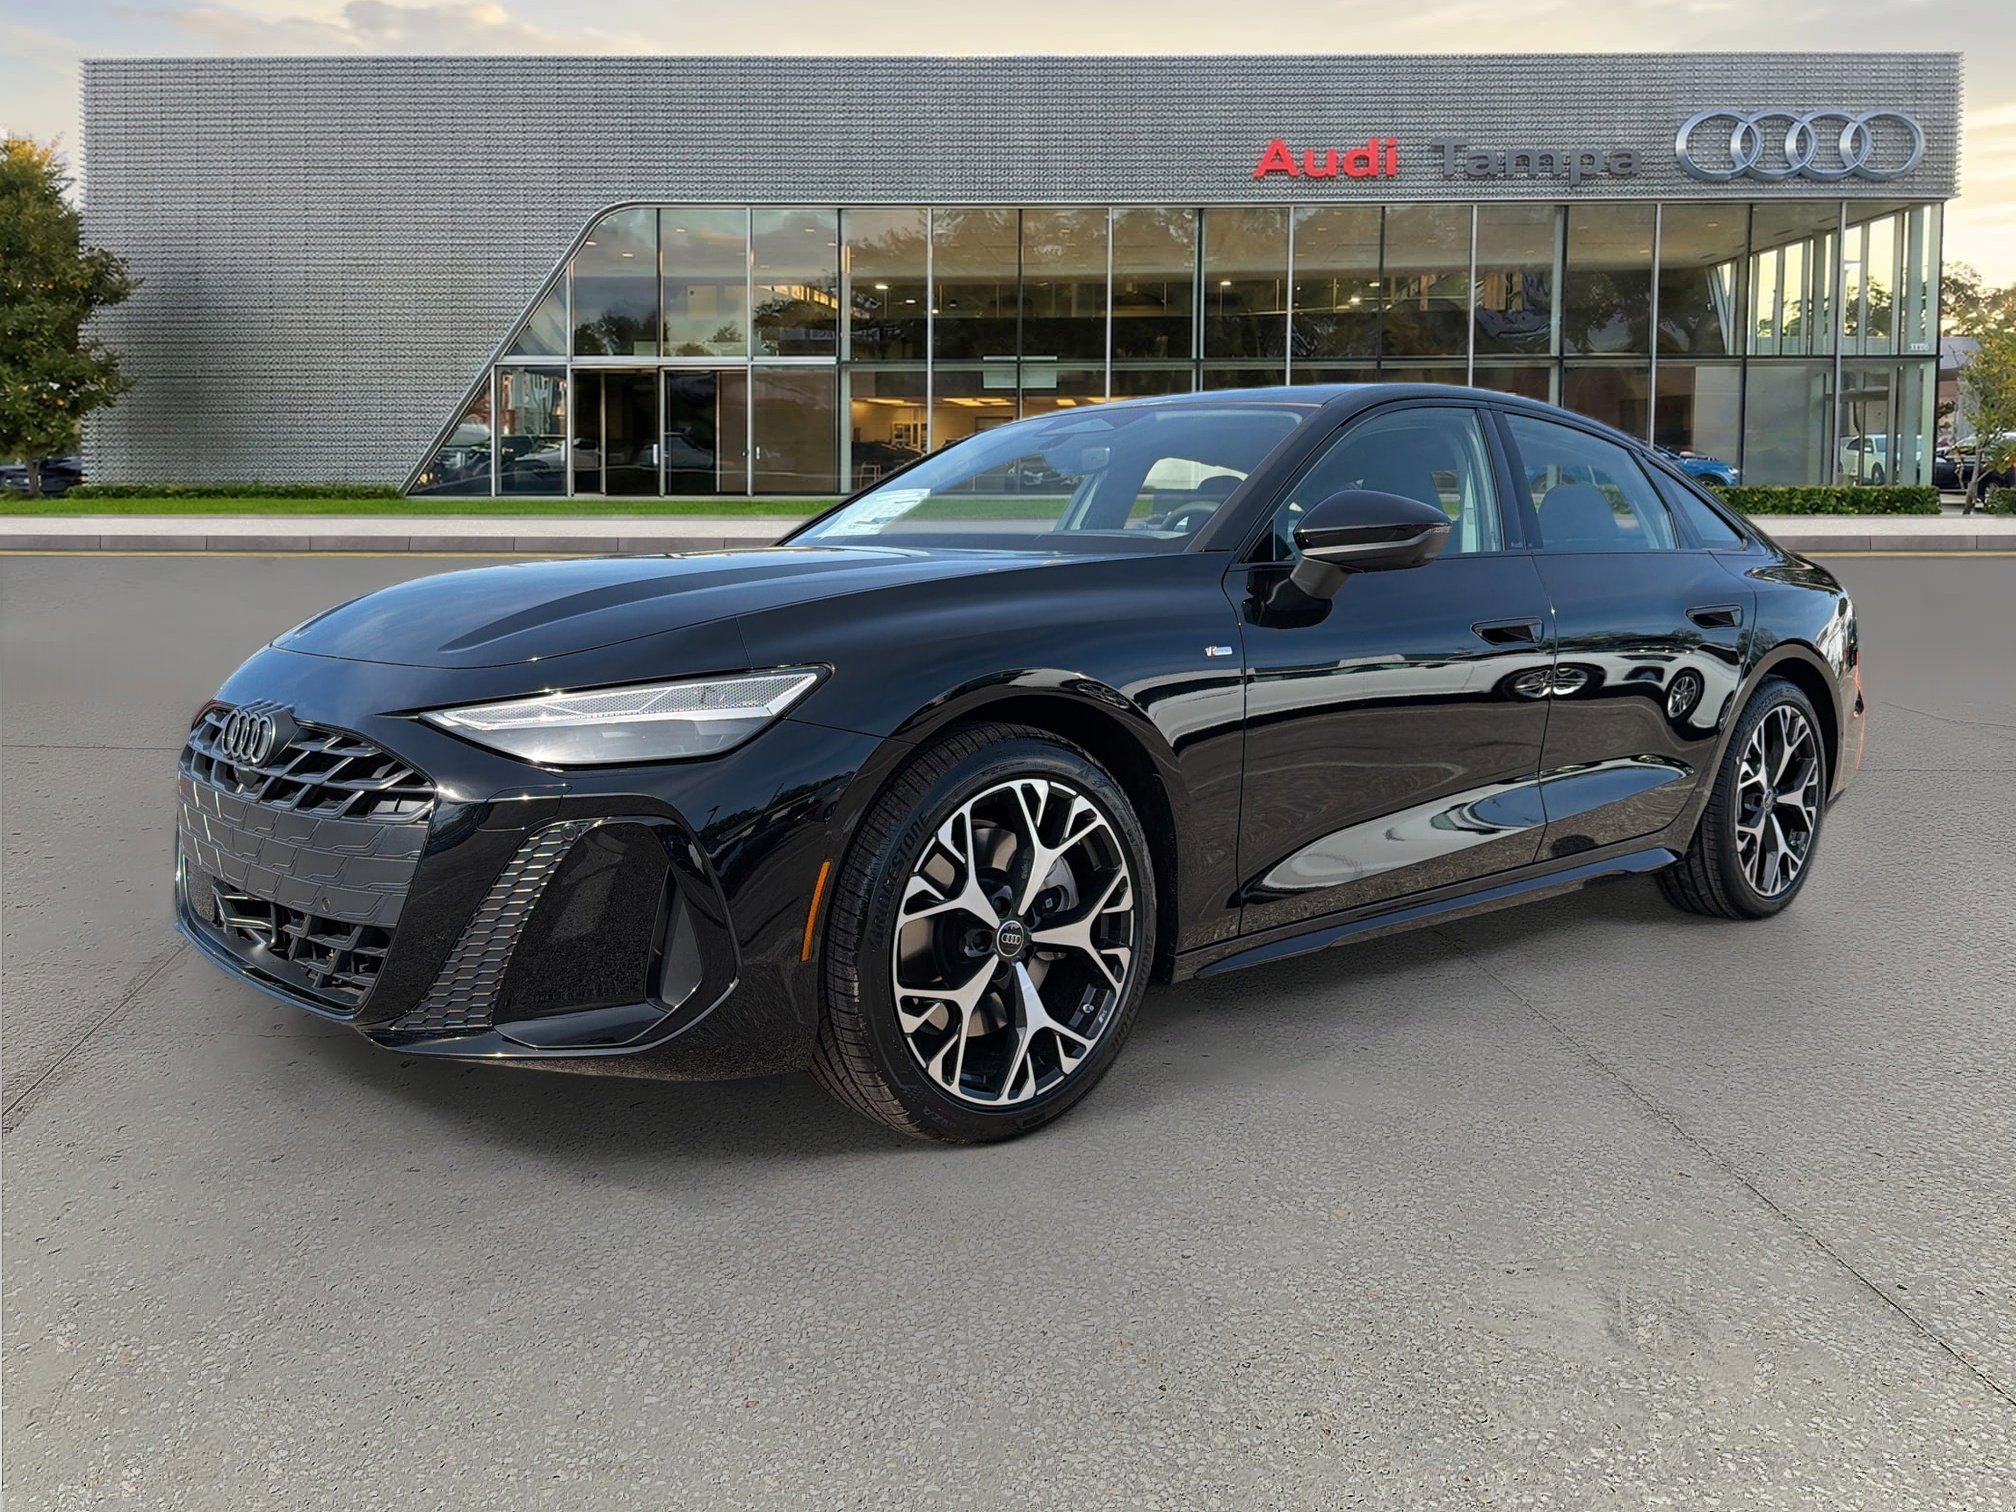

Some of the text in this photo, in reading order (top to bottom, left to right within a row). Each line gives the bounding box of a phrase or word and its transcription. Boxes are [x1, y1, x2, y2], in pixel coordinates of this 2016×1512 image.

[1253, 137, 1642, 187] Audi Tampa
[868, 811, 930, 946] BRIDGESTONE
